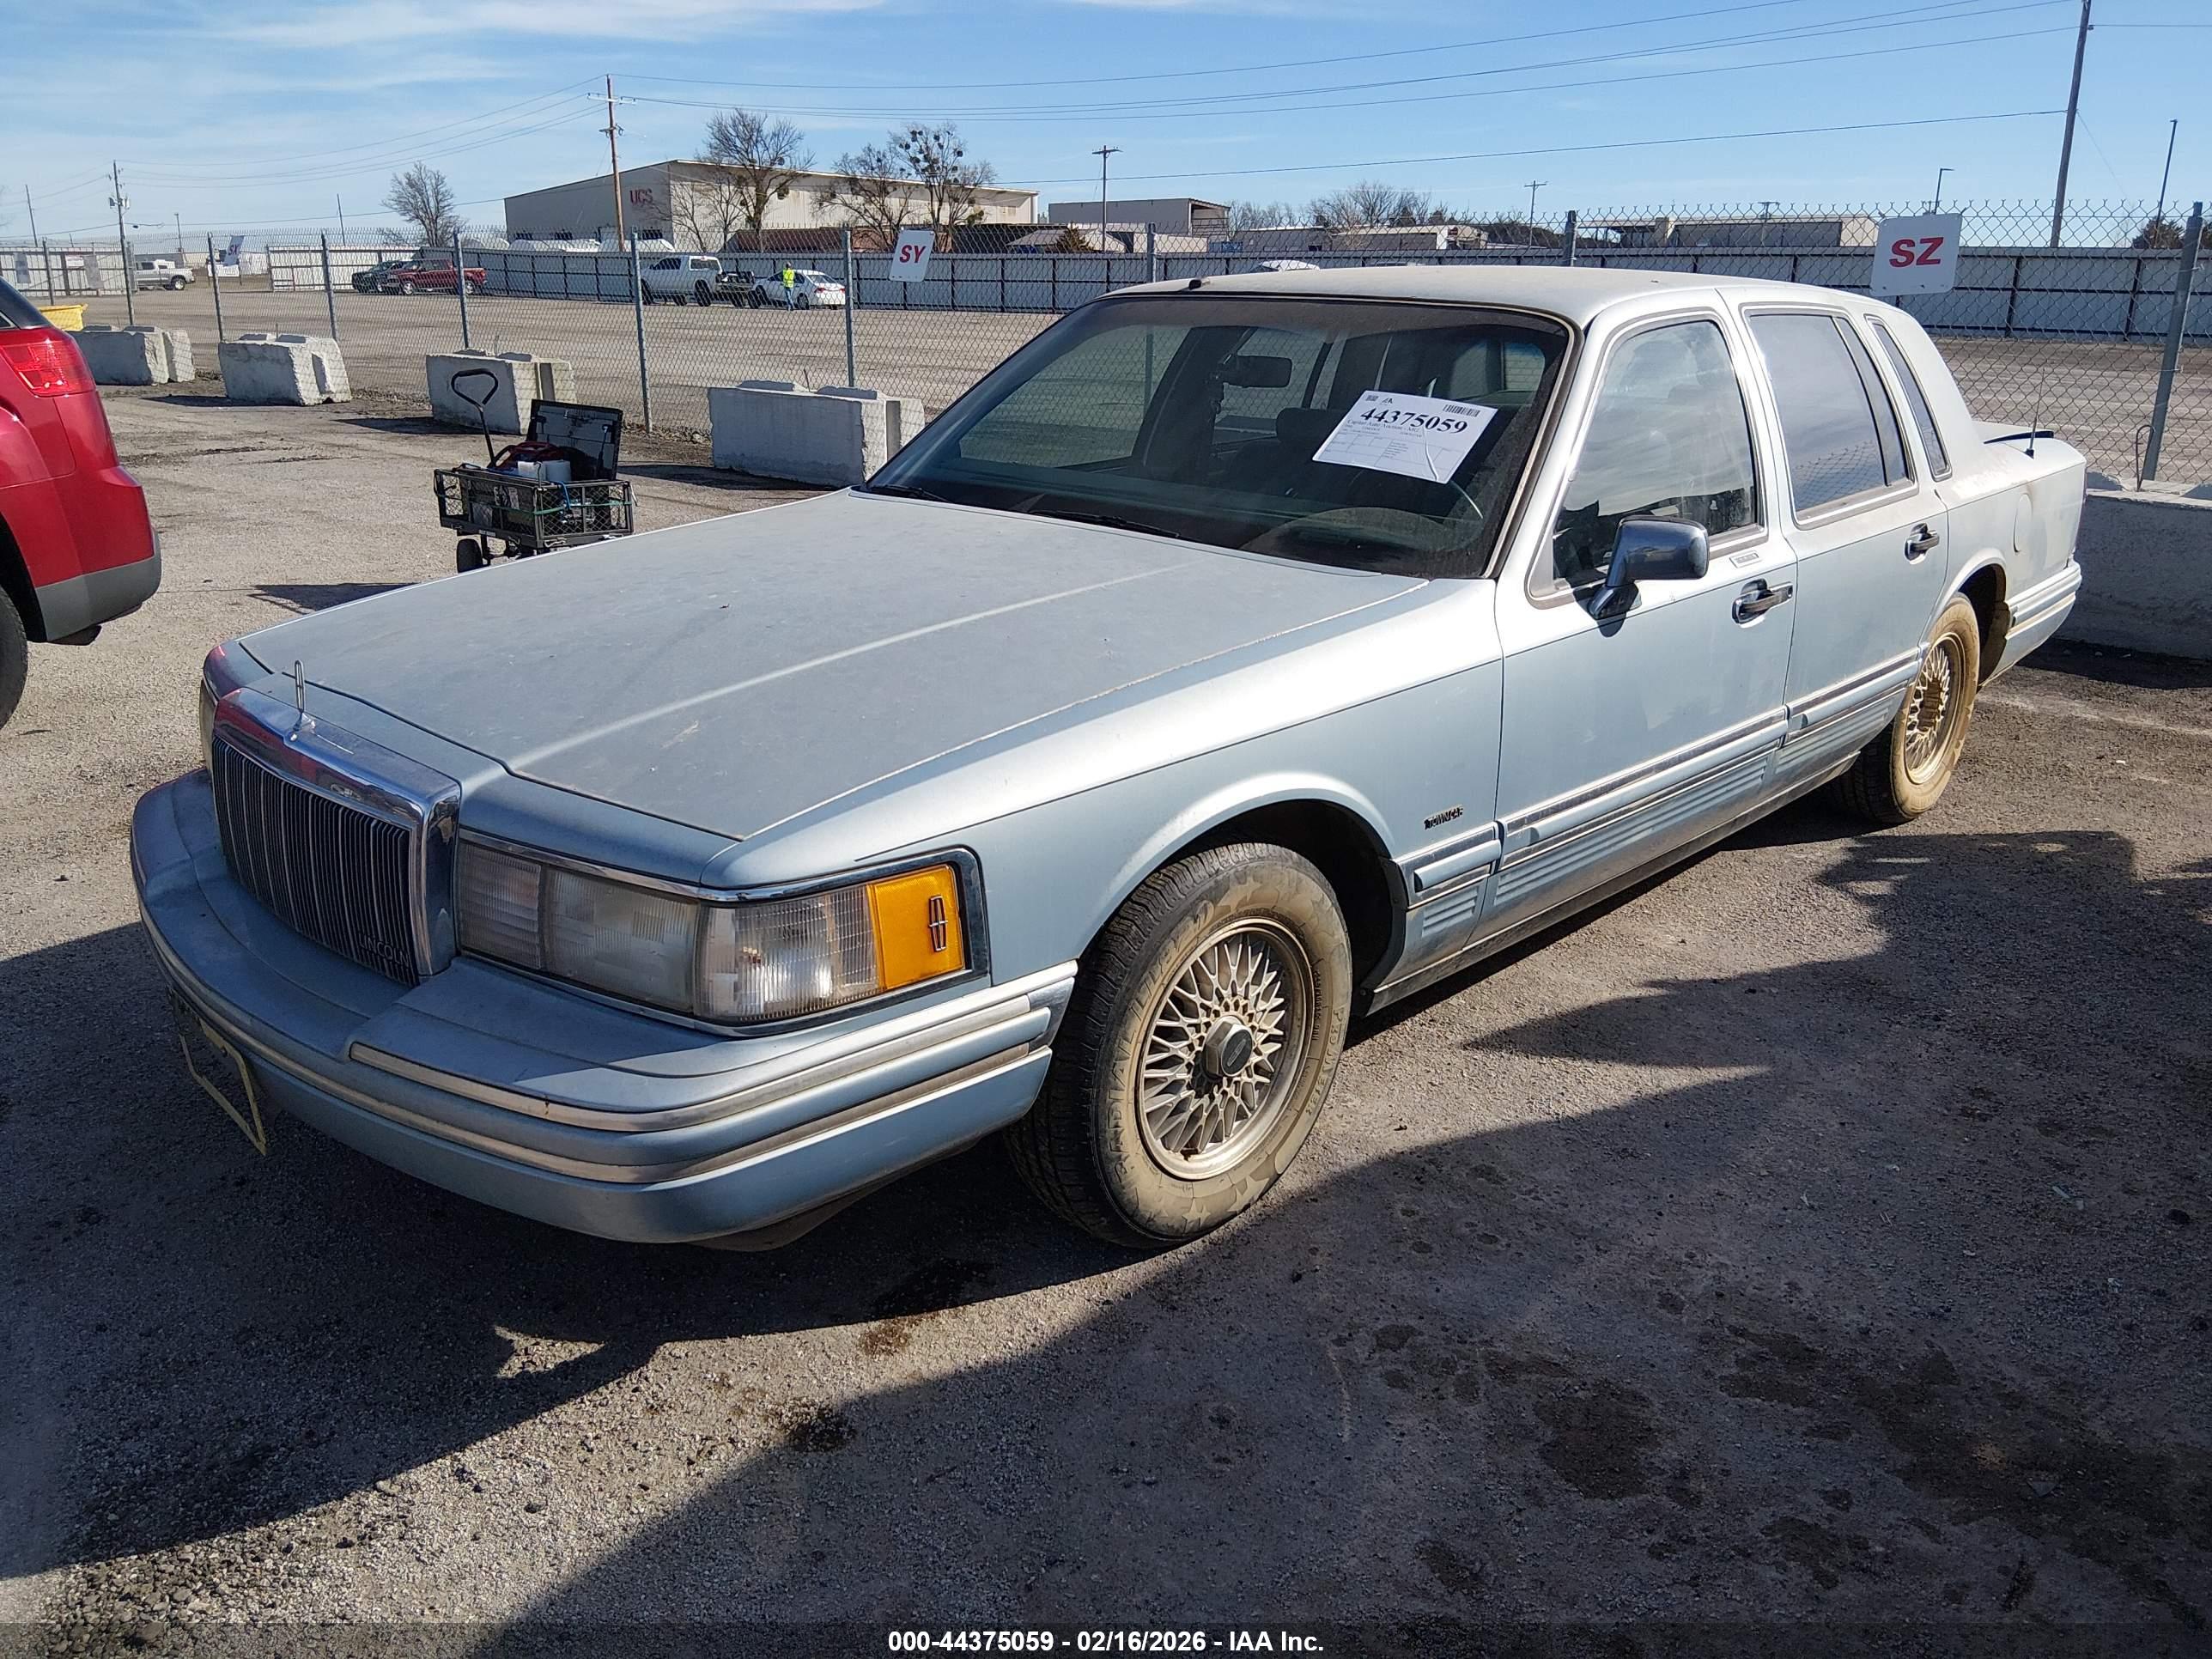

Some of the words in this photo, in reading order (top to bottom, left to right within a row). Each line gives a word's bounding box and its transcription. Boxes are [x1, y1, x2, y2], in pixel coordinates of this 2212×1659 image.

[899, 244, 927, 264] SY
[1889, 236, 1944, 268] SZ
[1360, 407, 1468, 434] 44375059
[360, 934, 410, 968] LINCOLN
